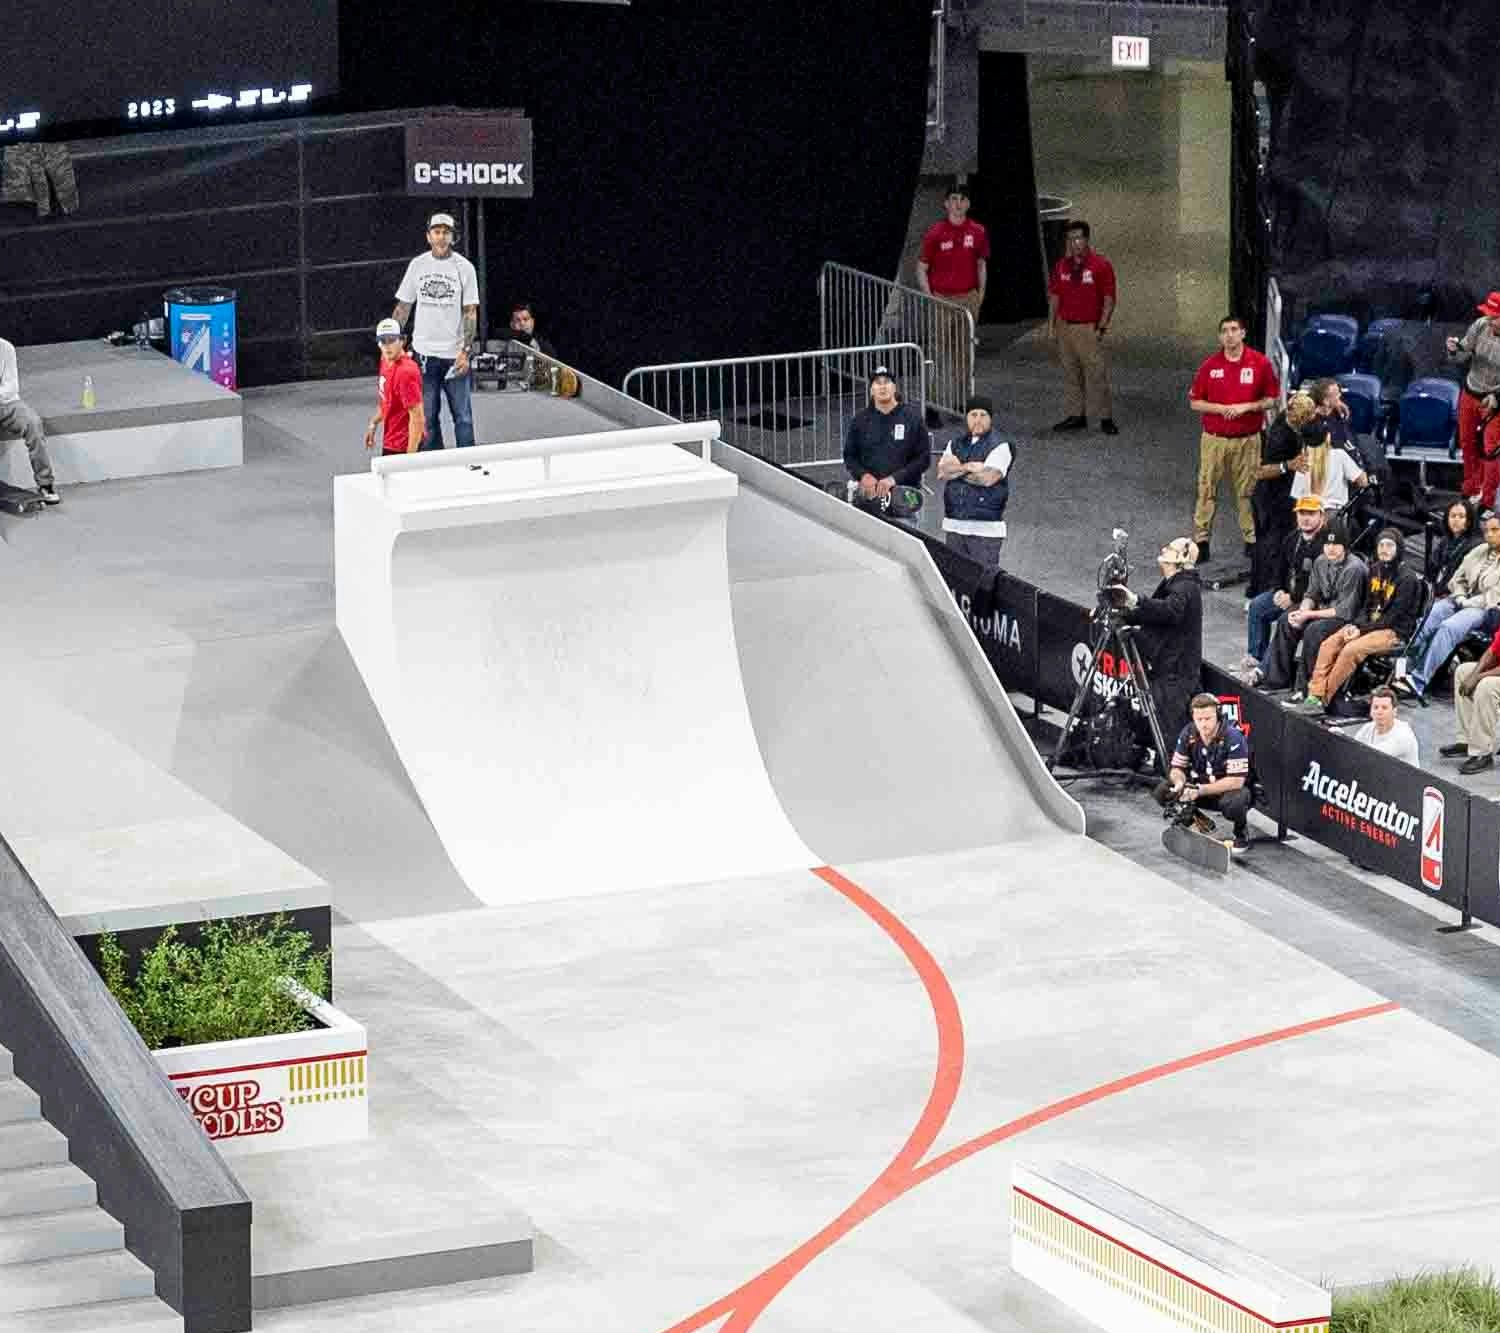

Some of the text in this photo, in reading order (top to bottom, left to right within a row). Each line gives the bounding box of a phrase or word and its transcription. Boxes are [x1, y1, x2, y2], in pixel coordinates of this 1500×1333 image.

[1118, 39, 1143, 62] EXIT
[414, 162, 525, 185] G-SHOCK
[192, 1083, 259, 1113] CUP
[200, 1104, 282, 1138] ODLES
